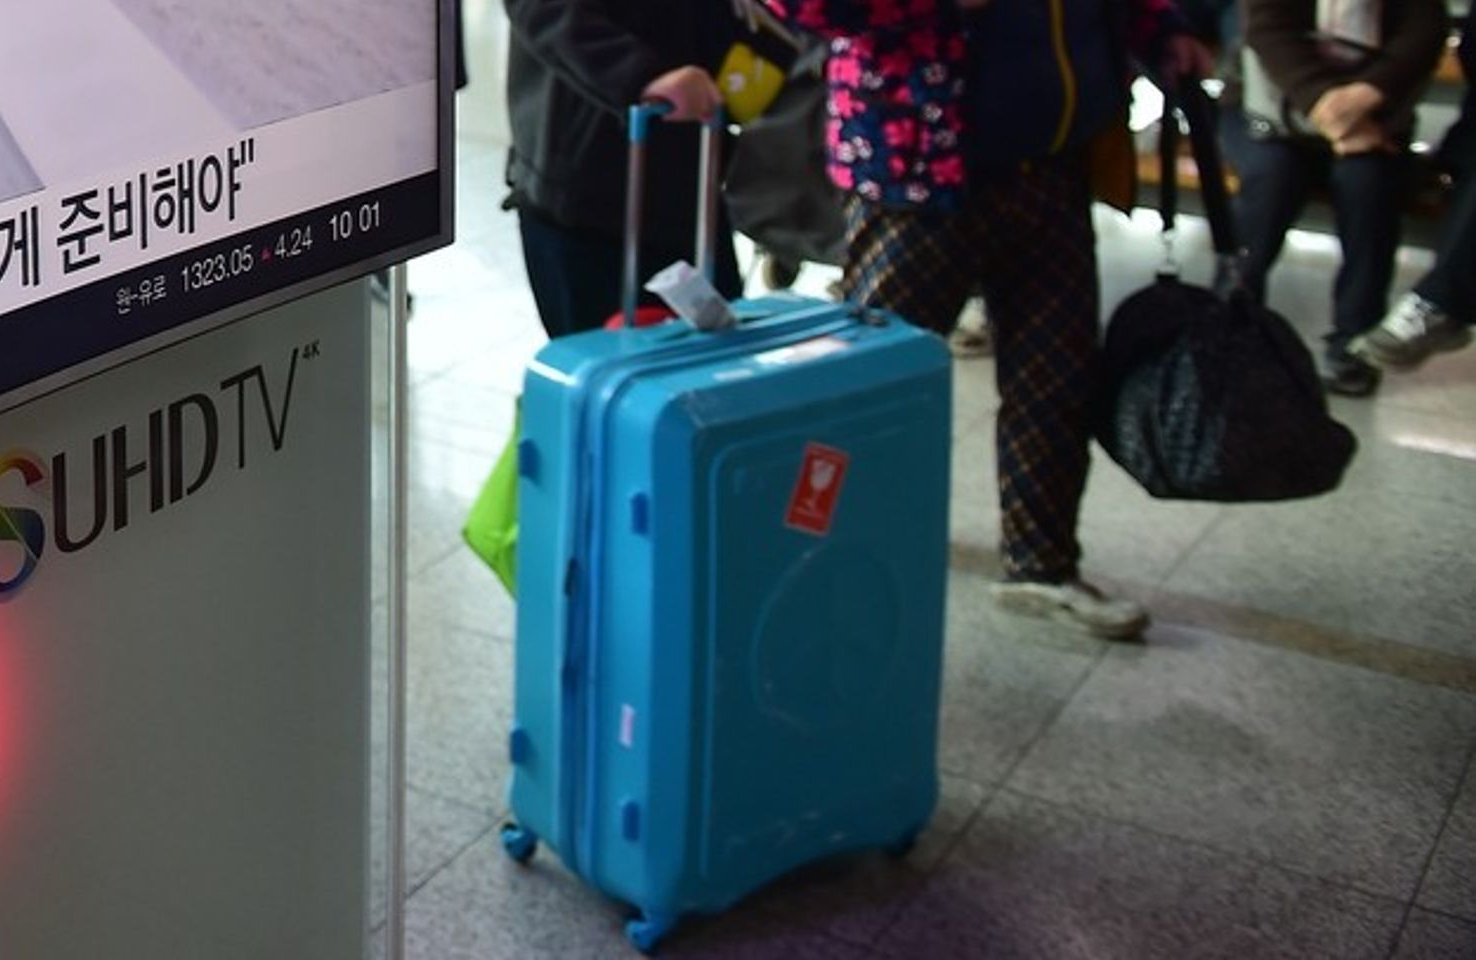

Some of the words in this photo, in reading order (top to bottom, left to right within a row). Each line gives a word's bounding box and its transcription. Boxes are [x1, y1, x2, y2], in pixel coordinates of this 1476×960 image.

[56, 137, 255, 275] 준비해야"
[180, 243, 255, 293] 1323.05
[273, 224, 314, 260] 4.24
